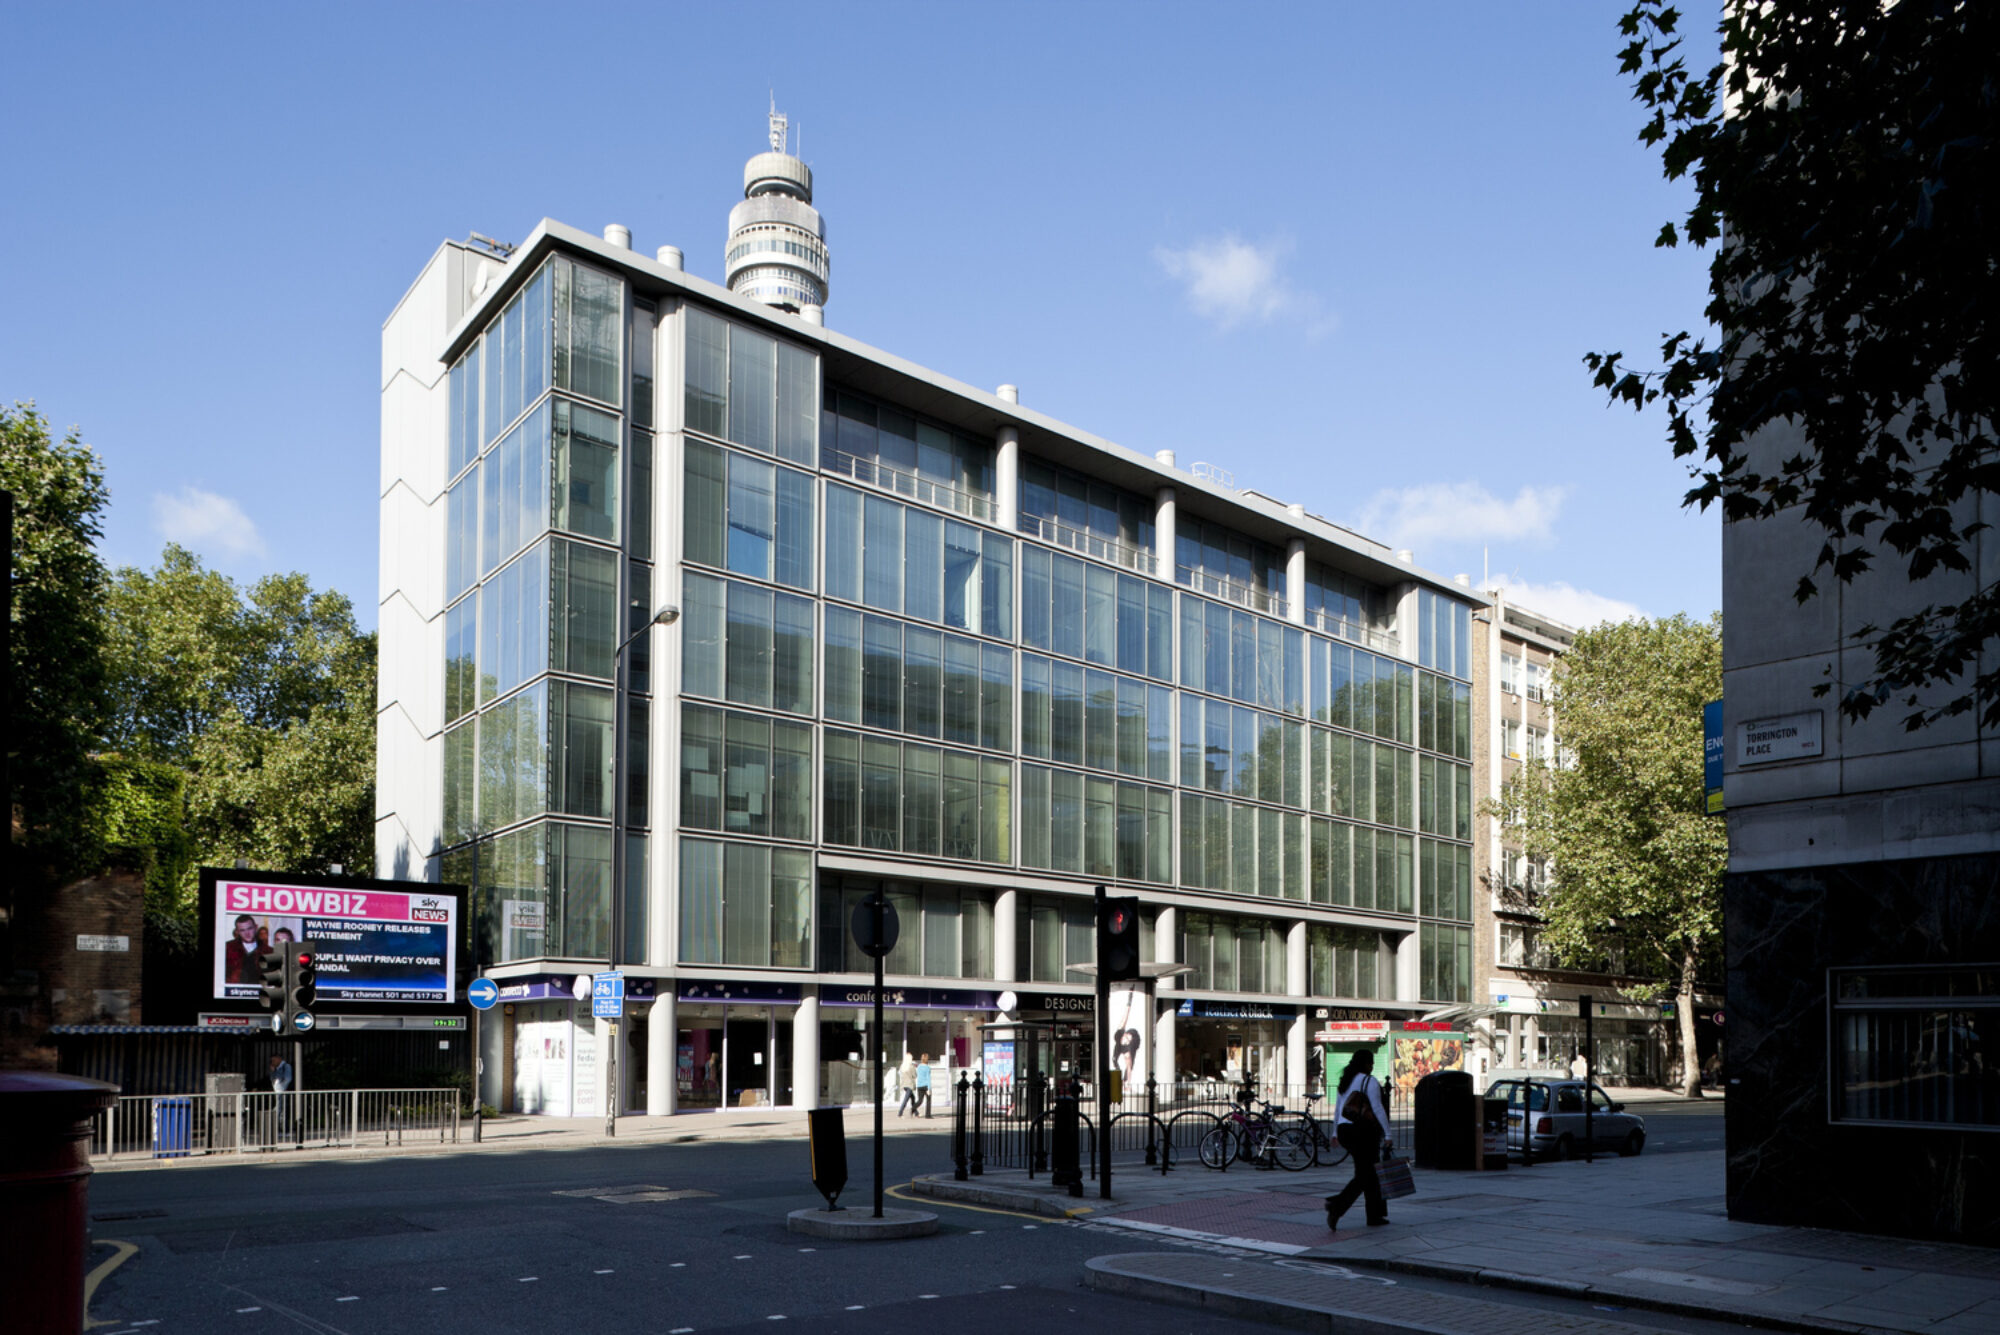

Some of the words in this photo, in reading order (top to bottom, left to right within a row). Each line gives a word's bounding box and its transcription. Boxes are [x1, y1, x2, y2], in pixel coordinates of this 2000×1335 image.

[1747, 728, 1797, 743] TORRINGTON
[1746, 744, 1771, 756] PLACE
[232, 886, 367, 915] SHOWBIZ
[422, 898, 440, 909] sky
[414, 909, 446, 920] NEWS
[306, 920, 341, 930] WAYNE
[343, 922, 382, 932] ROONEY
[384, 924, 431, 934] RELEASES
[306, 931, 363, 941] STATEMENT
[315, 953, 343, 963] OUPLE
[345, 954, 373, 963] WANT
[374, 955, 414, 965] PRIVACY
[416, 957, 441, 966] OVER
[341, 990, 354, 999] Sky
[355, 991, 384, 999] channel
[385, 991, 400, 999] 501
[846, 990, 890, 1002] confeti
[1248, 1003, 1273, 1019] black
[1350, 1009, 1386, 1020] WORKSHOP
